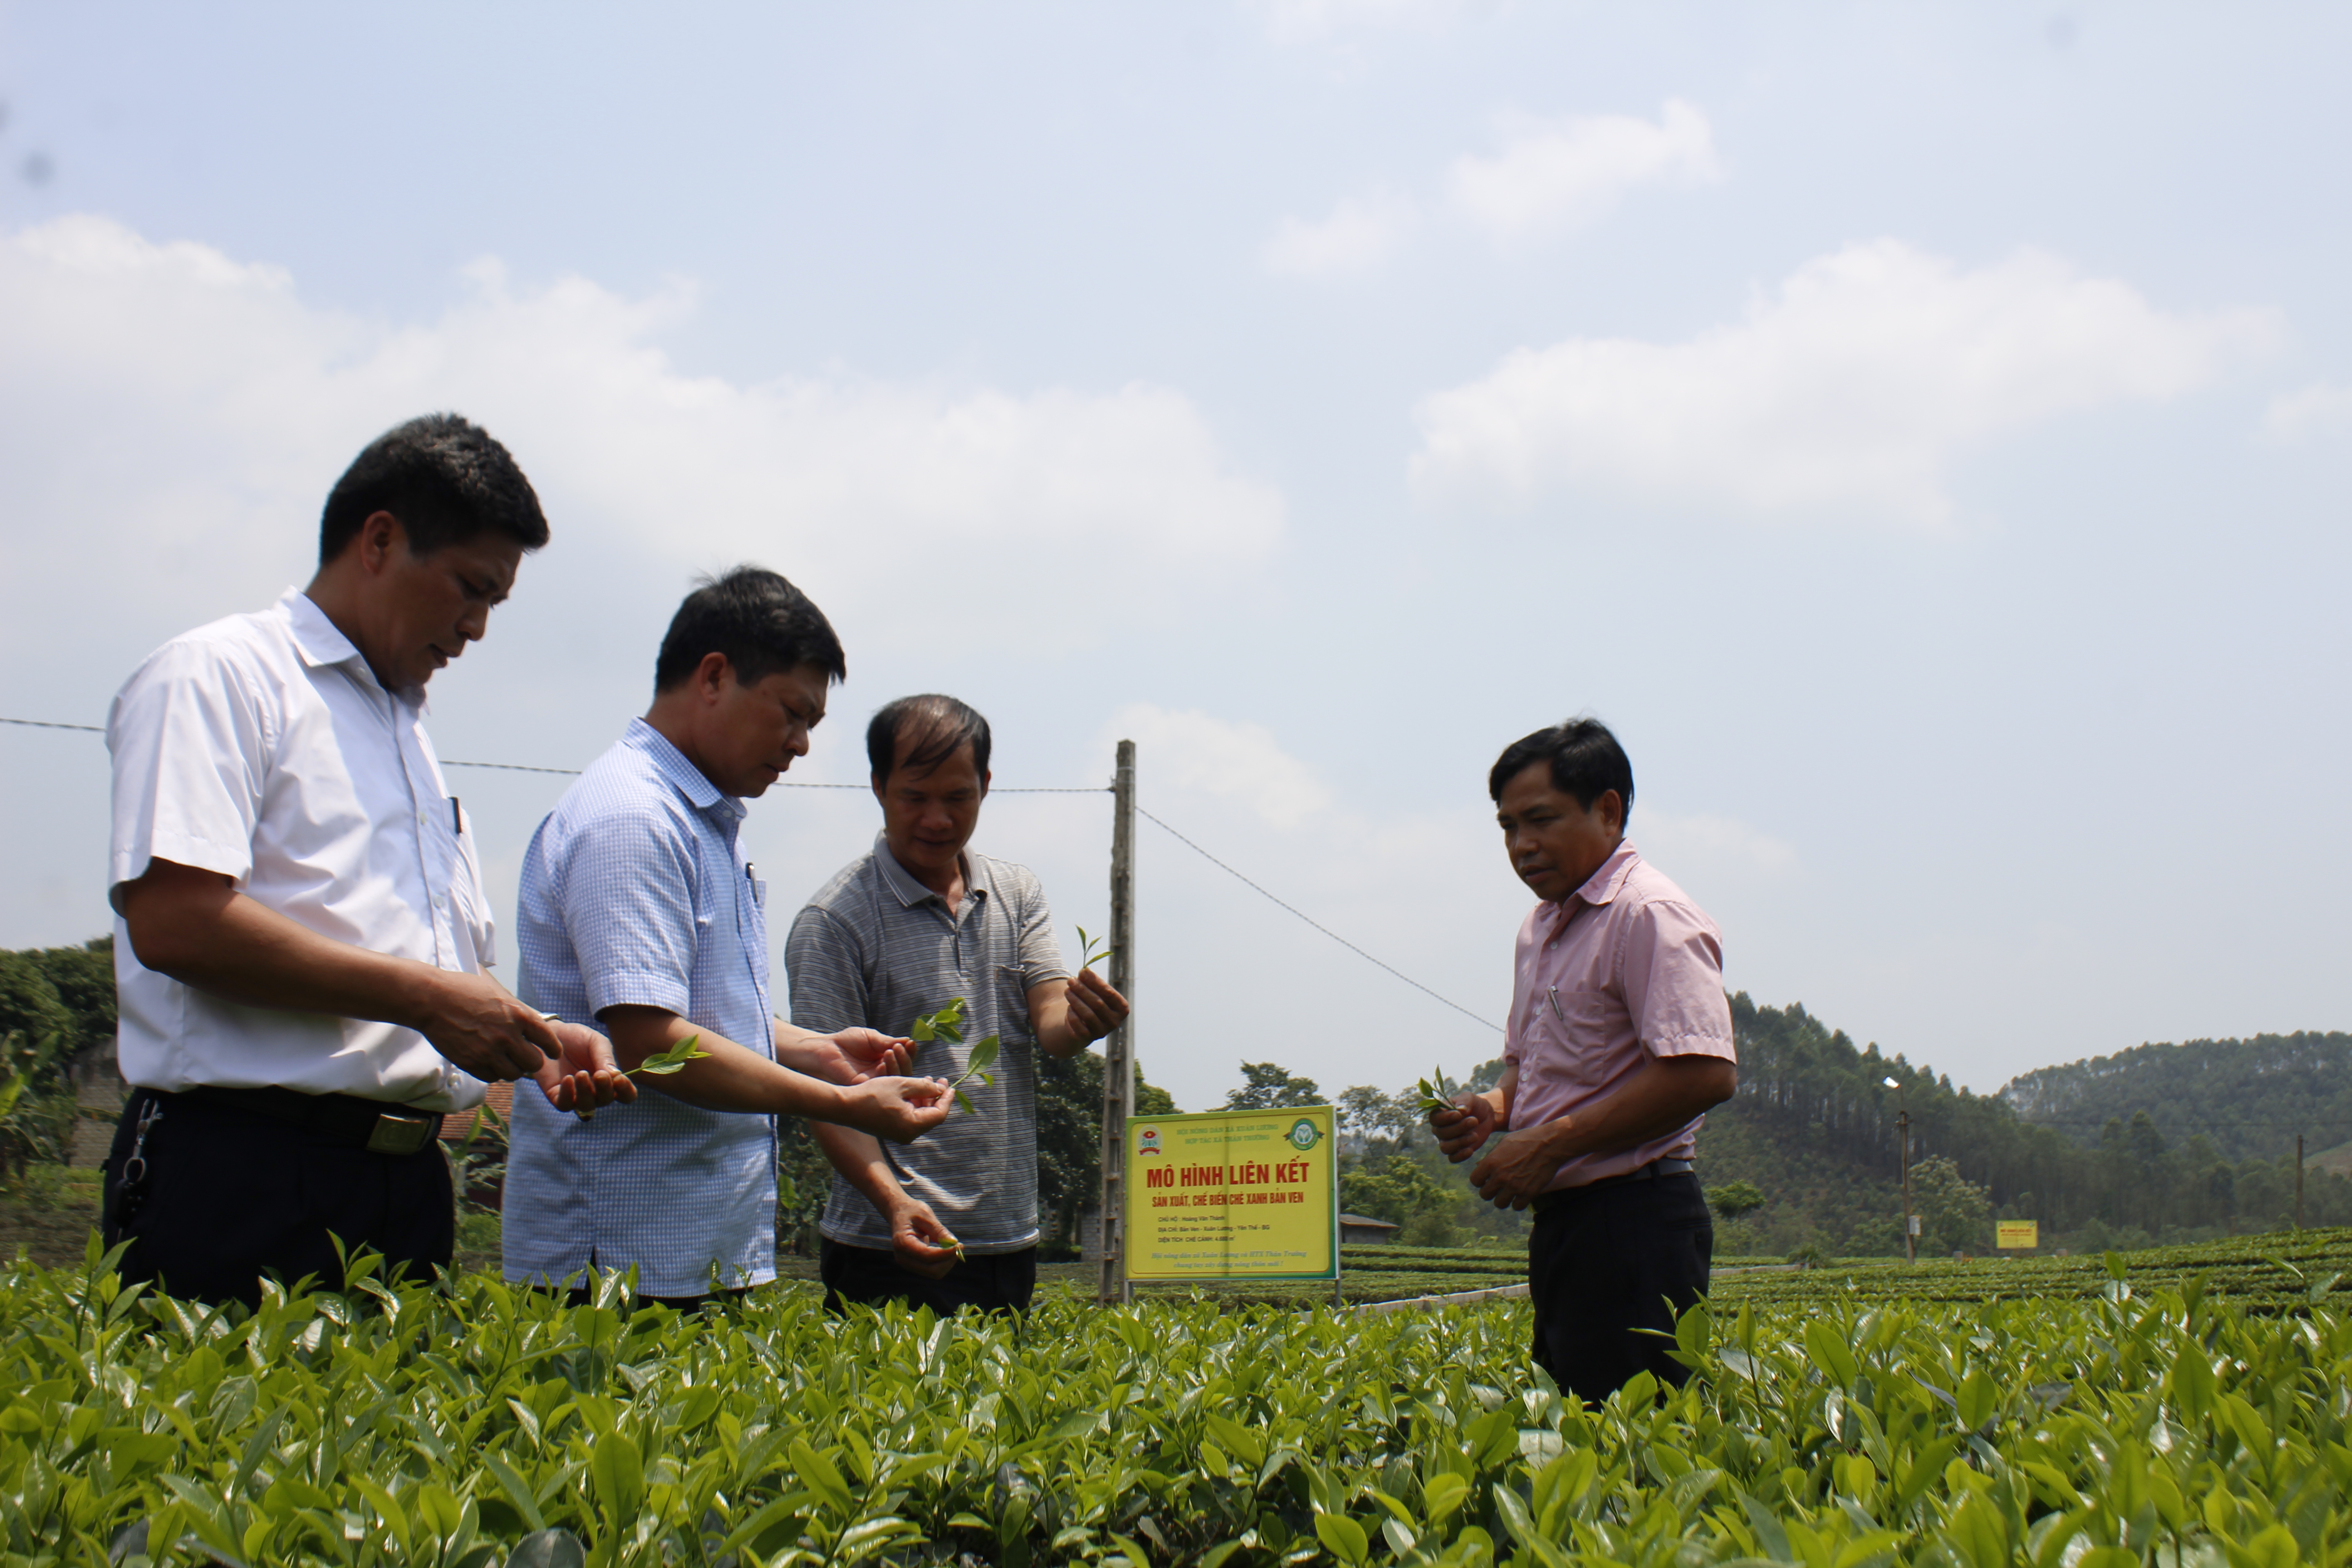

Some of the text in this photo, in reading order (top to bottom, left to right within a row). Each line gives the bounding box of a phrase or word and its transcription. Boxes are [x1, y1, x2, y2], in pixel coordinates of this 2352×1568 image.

[1147, 1155, 1309, 1188] MÔ HÌNH LIÊN KẾT
[1152, 1188, 1303, 1207] SẢN XUẤT, CHẾ BIẾN CHÈ XANH BẢN VEN
